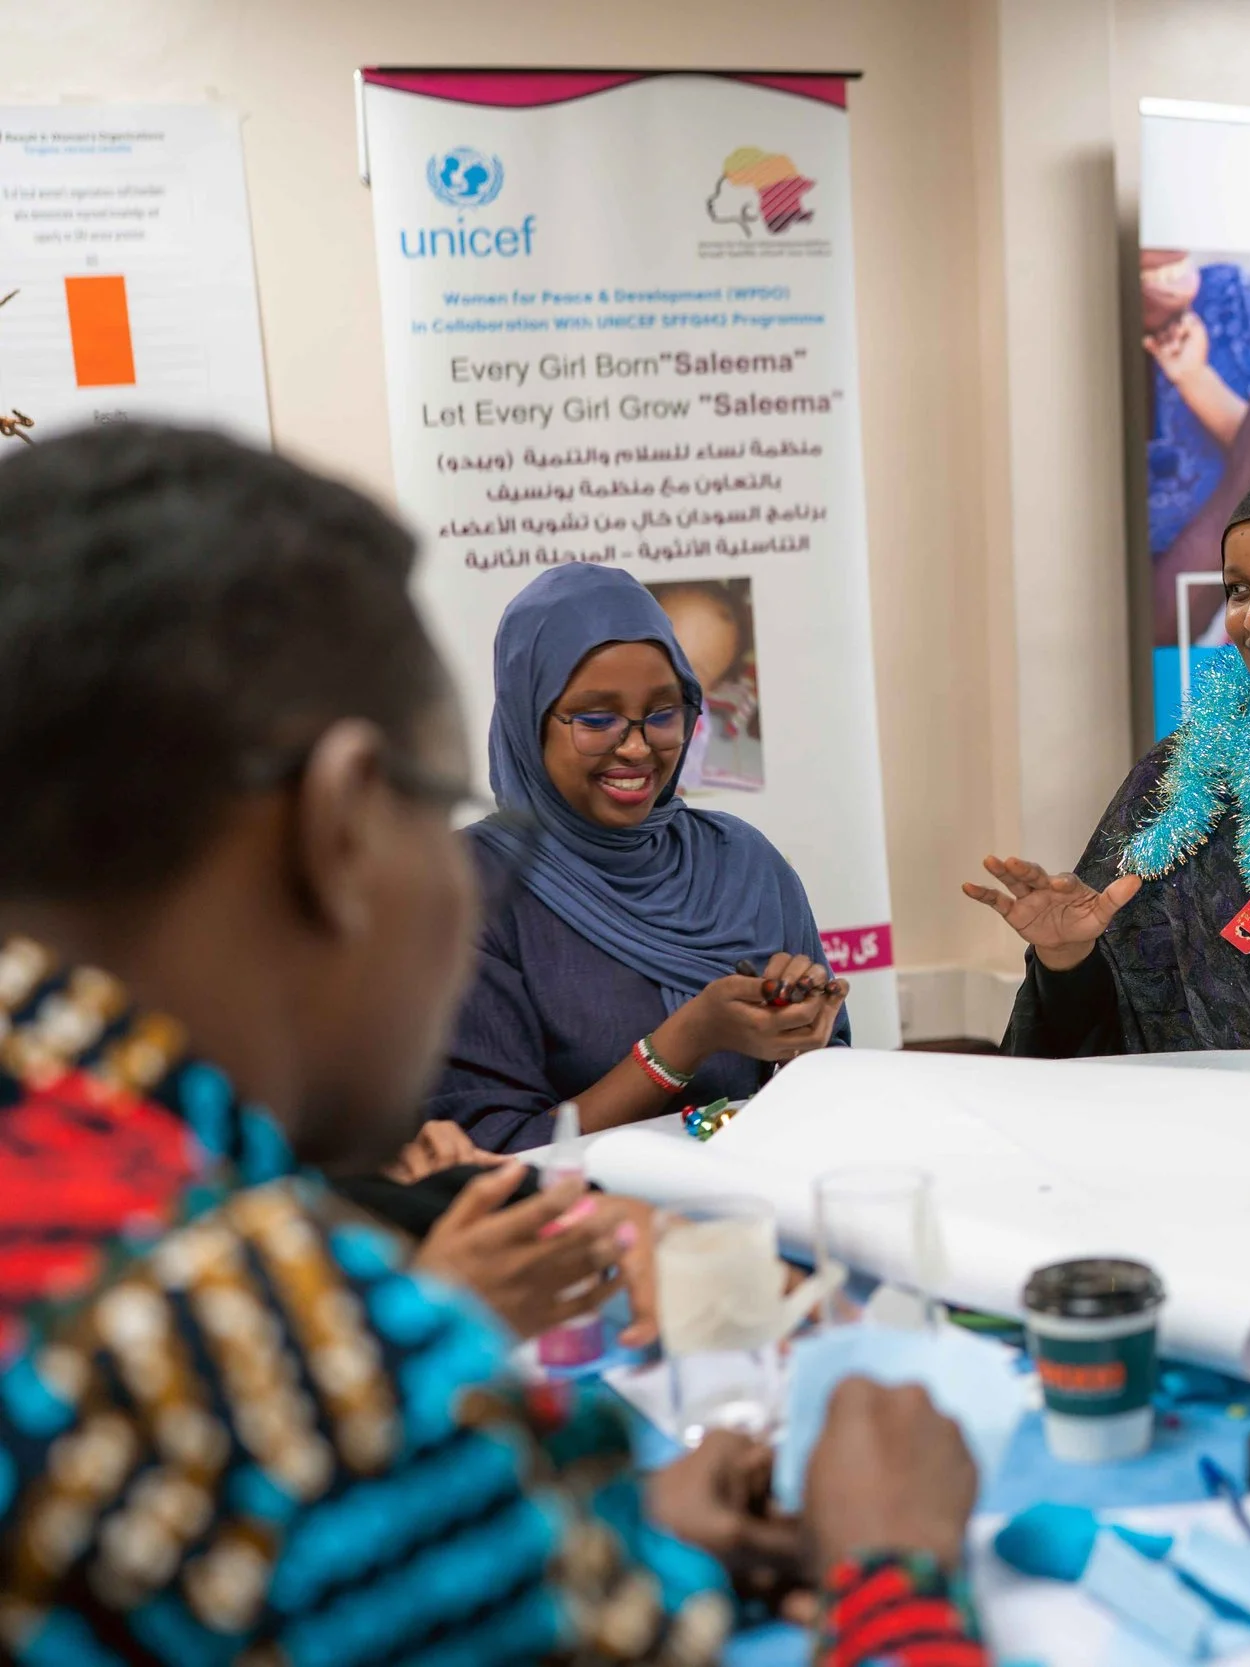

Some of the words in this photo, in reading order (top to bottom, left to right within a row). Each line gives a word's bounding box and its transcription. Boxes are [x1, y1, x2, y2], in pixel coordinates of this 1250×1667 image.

[399, 214, 538, 259] unicef
[443, 290, 507, 306] Women
[512, 288, 535, 304] for
[542, 289, 593, 305] Peace
[598, 289, 609, 303] &
[614, 287, 721, 305] Development
[432, 317, 549, 333] Collaboration
[597, 315, 655, 330] UNICEF
[732, 312, 825, 330] Programme
[450, 355, 530, 387] Every
[538, 352, 587, 381] Girl
[422, 403, 465, 428] Let
[476, 398, 554, 429] Every
[563, 394, 609, 423] Girl
[619, 393, 691, 421] Grow
[698, 389, 843, 417] "Saleema"
[524, 446, 610, 468] والتنمية
[614, 442, 691, 466] للسلام
[696, 441, 746, 461] نساء
[750, 438, 822, 460] منظمة
[580, 479, 654, 500] منظمة
[660, 476, 690, 498] مع
[694, 473, 782, 496] بالتعاون
[522, 511, 589, 537] تشويه
[594, 513, 626, 533] من
[676, 505, 761, 530] السودان
[765, 502, 827, 525] برنامج
[439, 514, 516, 539] الأعضاء
[535, 545, 616, 567] المرحلة
[638, 536, 711, 562] الأنثوية
[715, 534, 810, 559] التناسلية
[465, 546, 530, 571] الثانية
